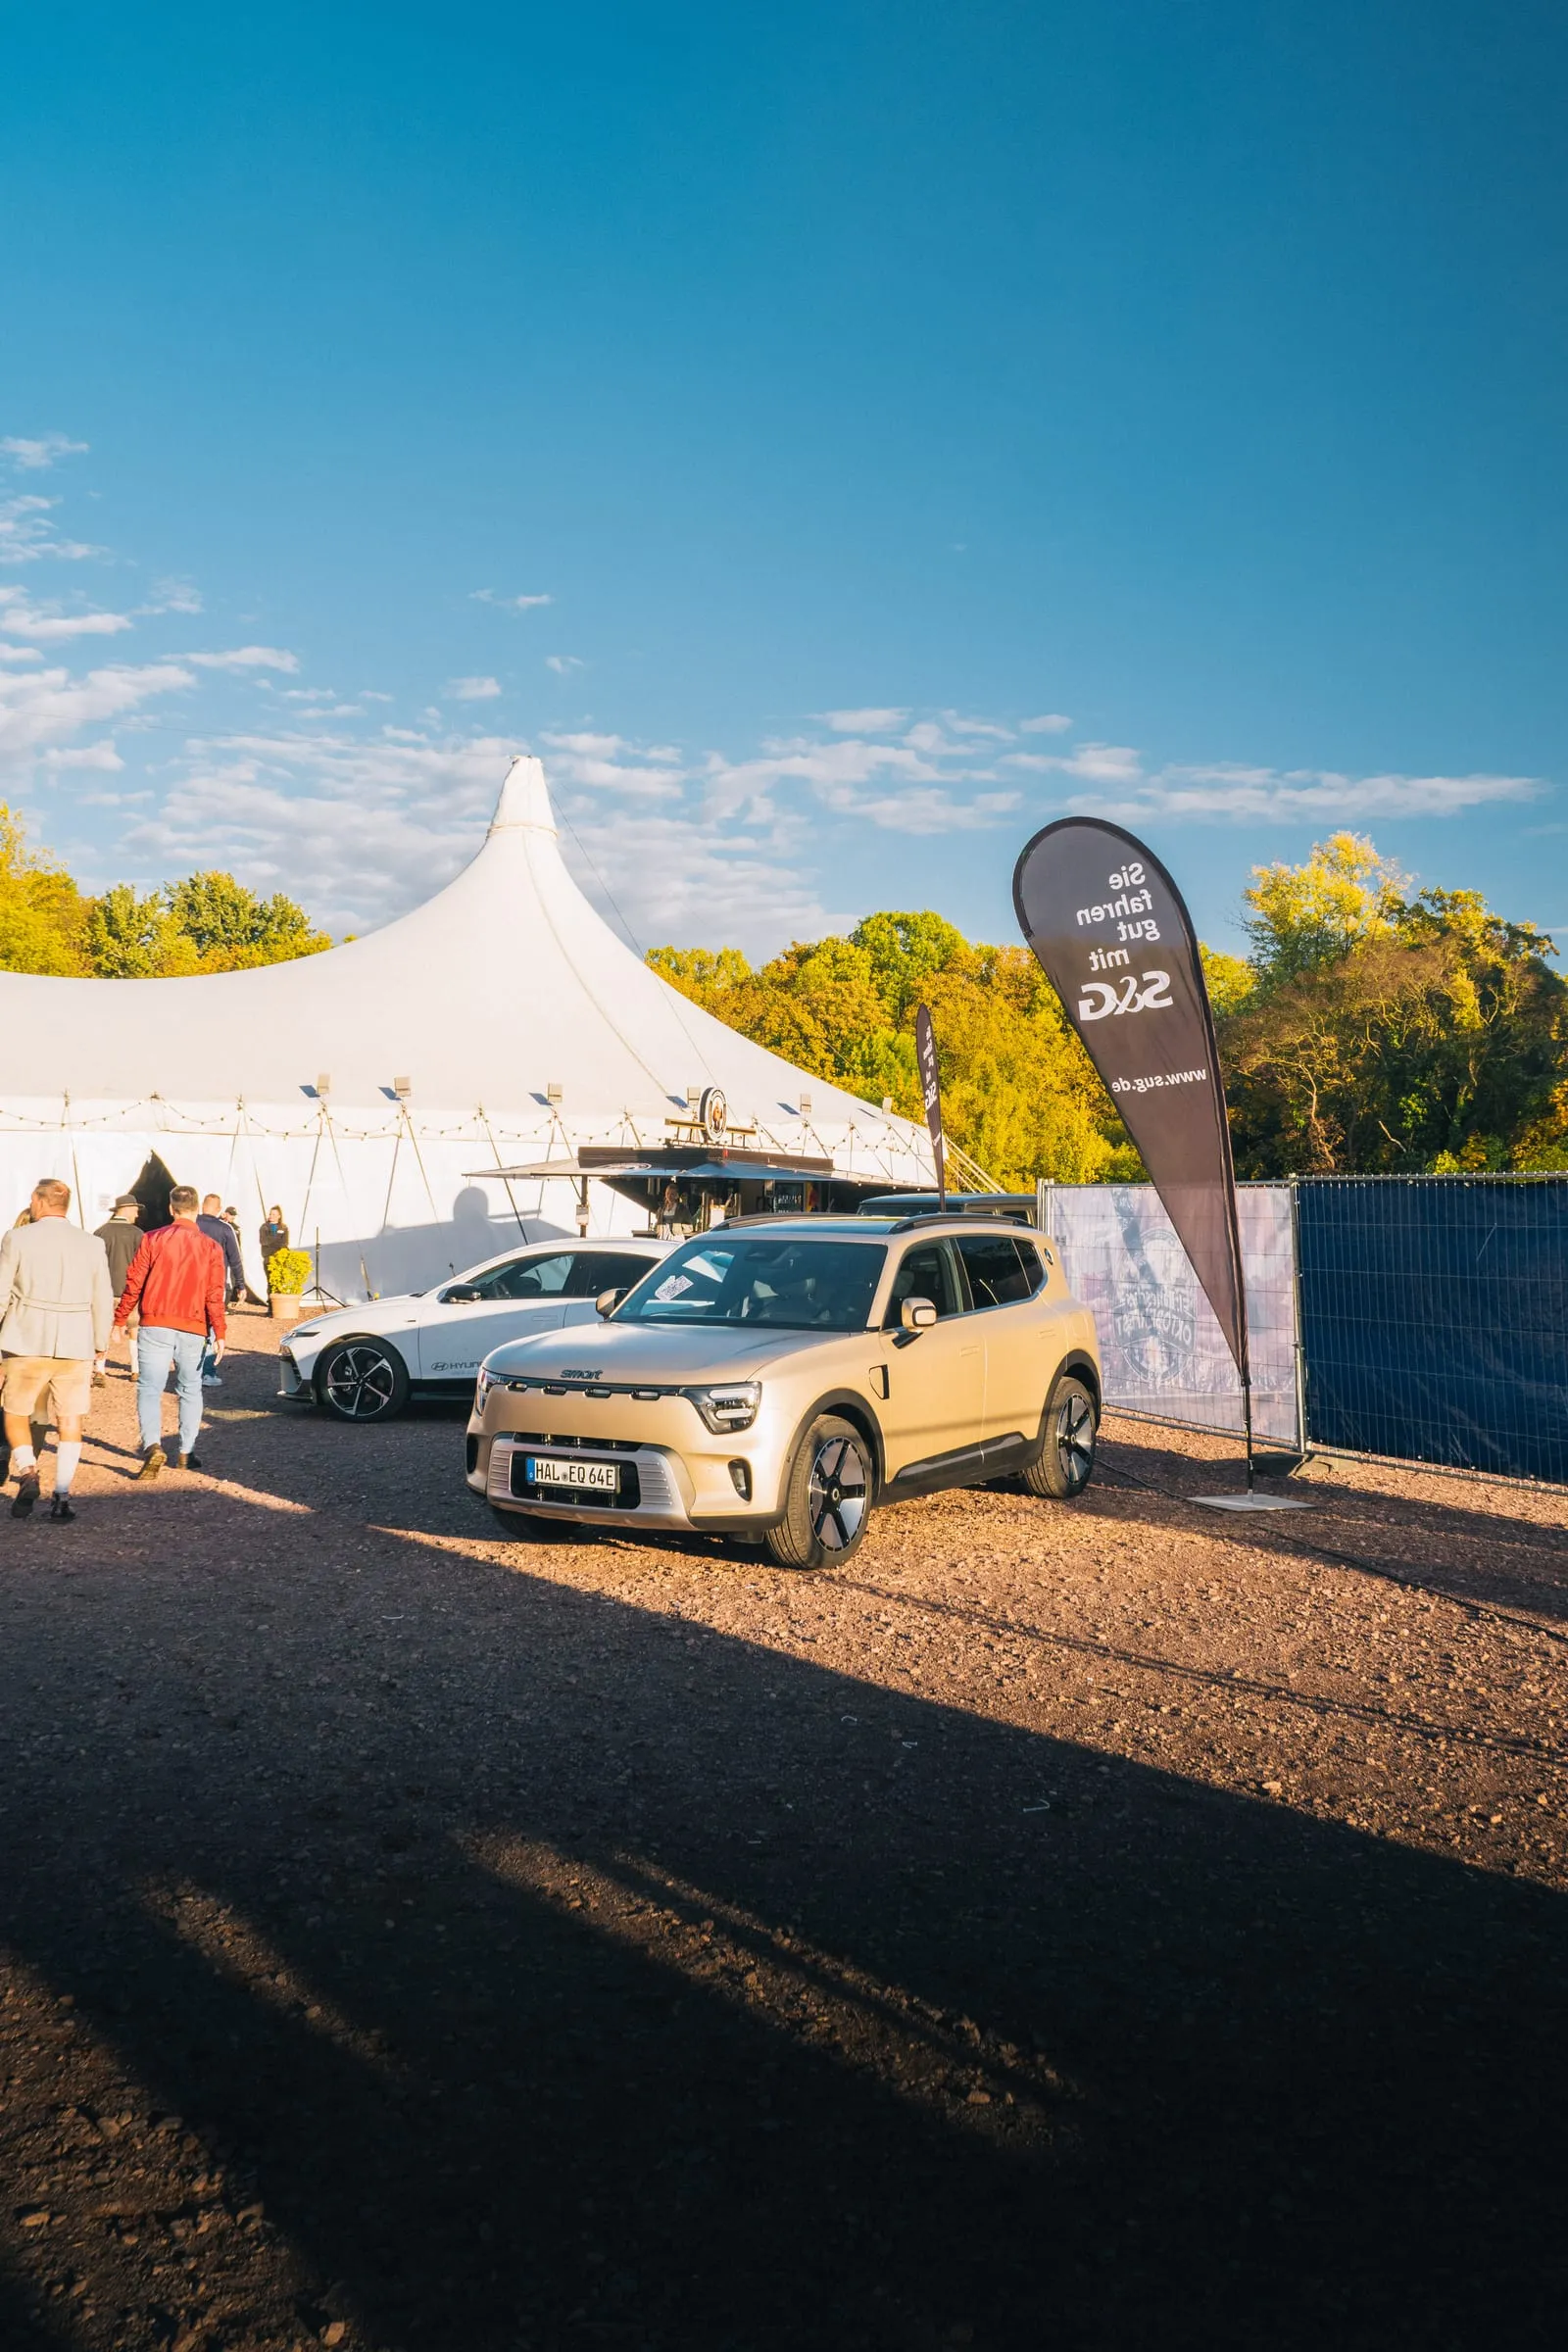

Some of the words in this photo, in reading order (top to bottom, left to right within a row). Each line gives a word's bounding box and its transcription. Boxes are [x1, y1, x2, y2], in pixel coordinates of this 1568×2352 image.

[561, 1369, 604, 1380] smart
[536, 1462, 560, 1481] HAL
[569, 1466, 585, 1483] EQ
[589, 1467, 613, 1487] 64E
